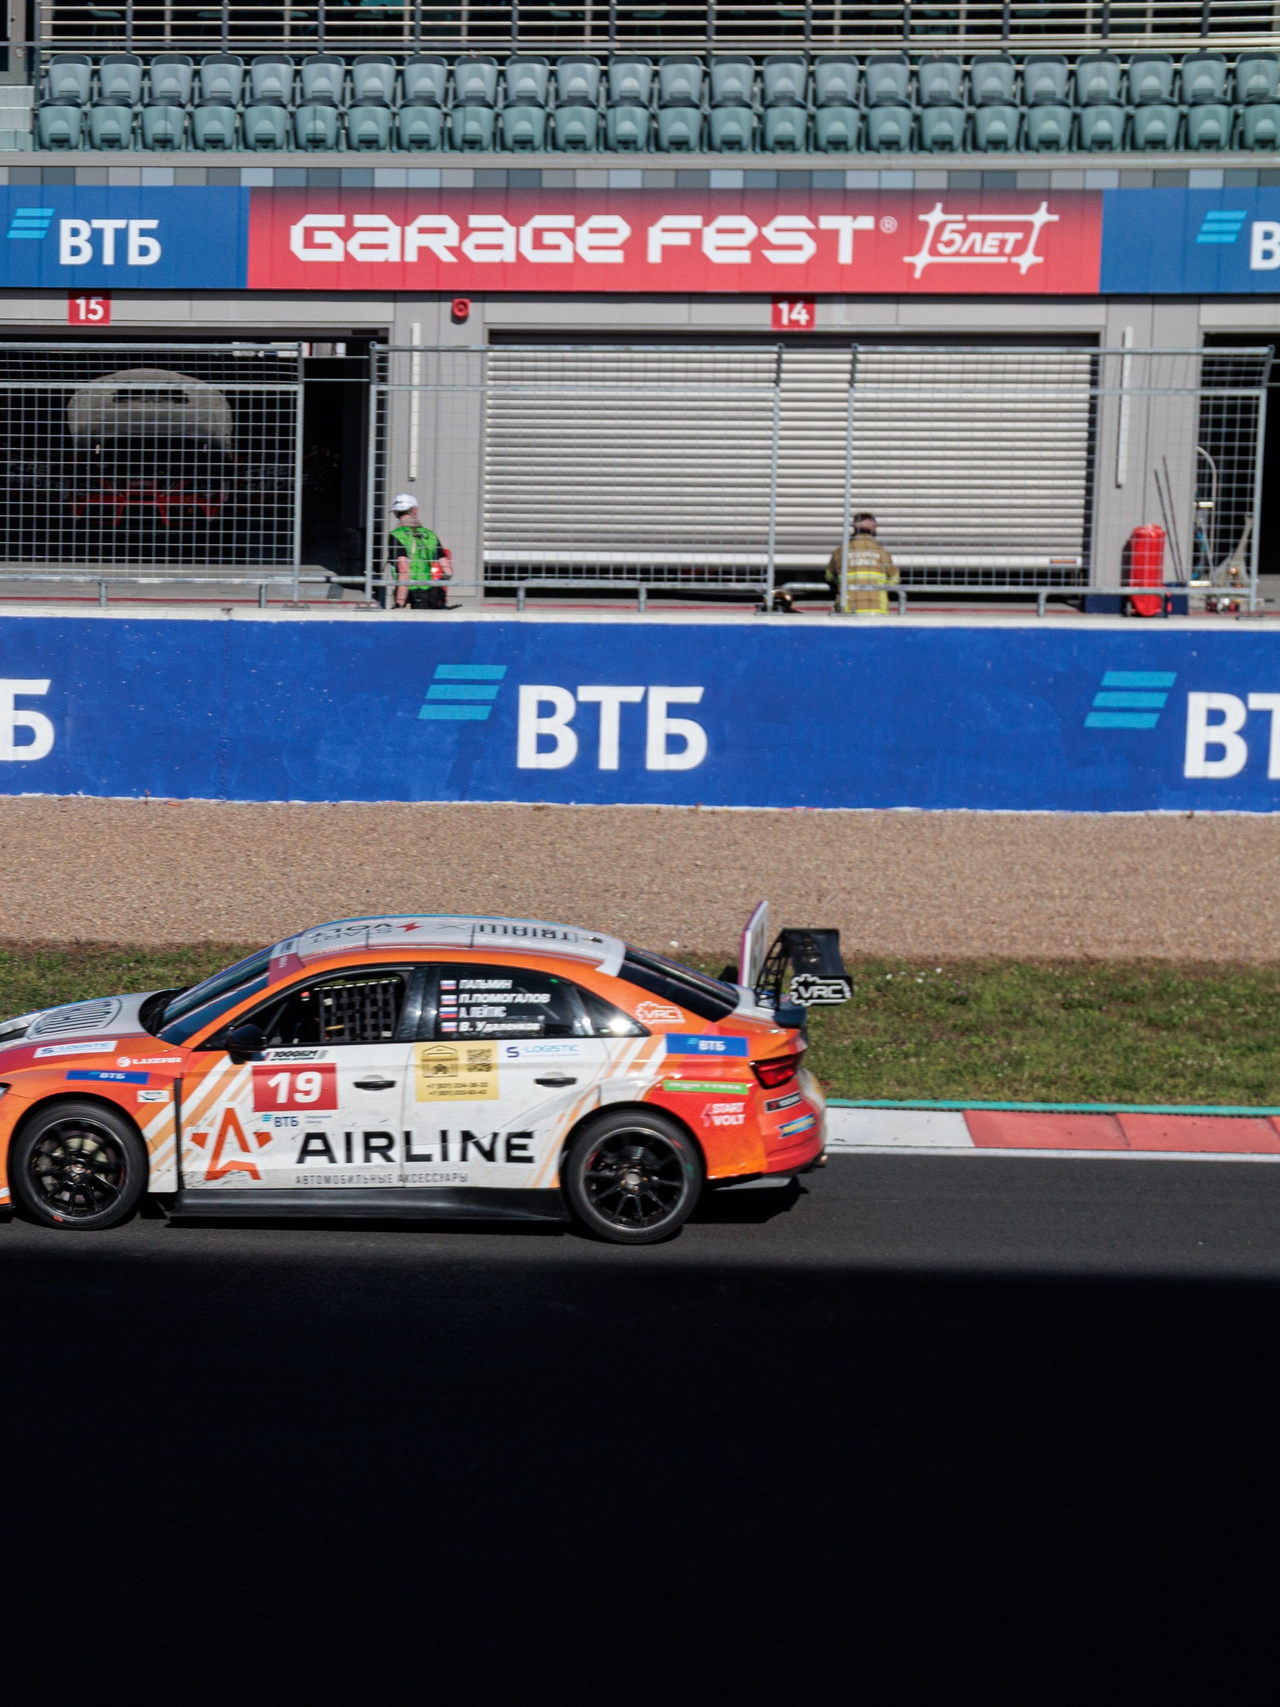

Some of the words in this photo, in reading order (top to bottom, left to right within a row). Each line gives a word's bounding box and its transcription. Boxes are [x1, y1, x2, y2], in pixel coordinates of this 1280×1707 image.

[59, 218, 162, 266] ВТБ
[75, 299, 105, 321] 15
[778, 303, 810, 326] 14
[516, 684, 709, 771] ВТБ
[698, 1039, 726, 1051] ВТБ
[266, 1071, 323, 1104] 19
[274, 1115, 299, 1128] ВТБ
[712, 1114, 746, 1126] VOLT
[295, 1129, 536, 1165] AIRLINE
[295, 1173, 394, 1186] АВТОМОБИЛЬНЫЕ
[397, 1172, 469, 1184] АКСЕССУАРЫ
